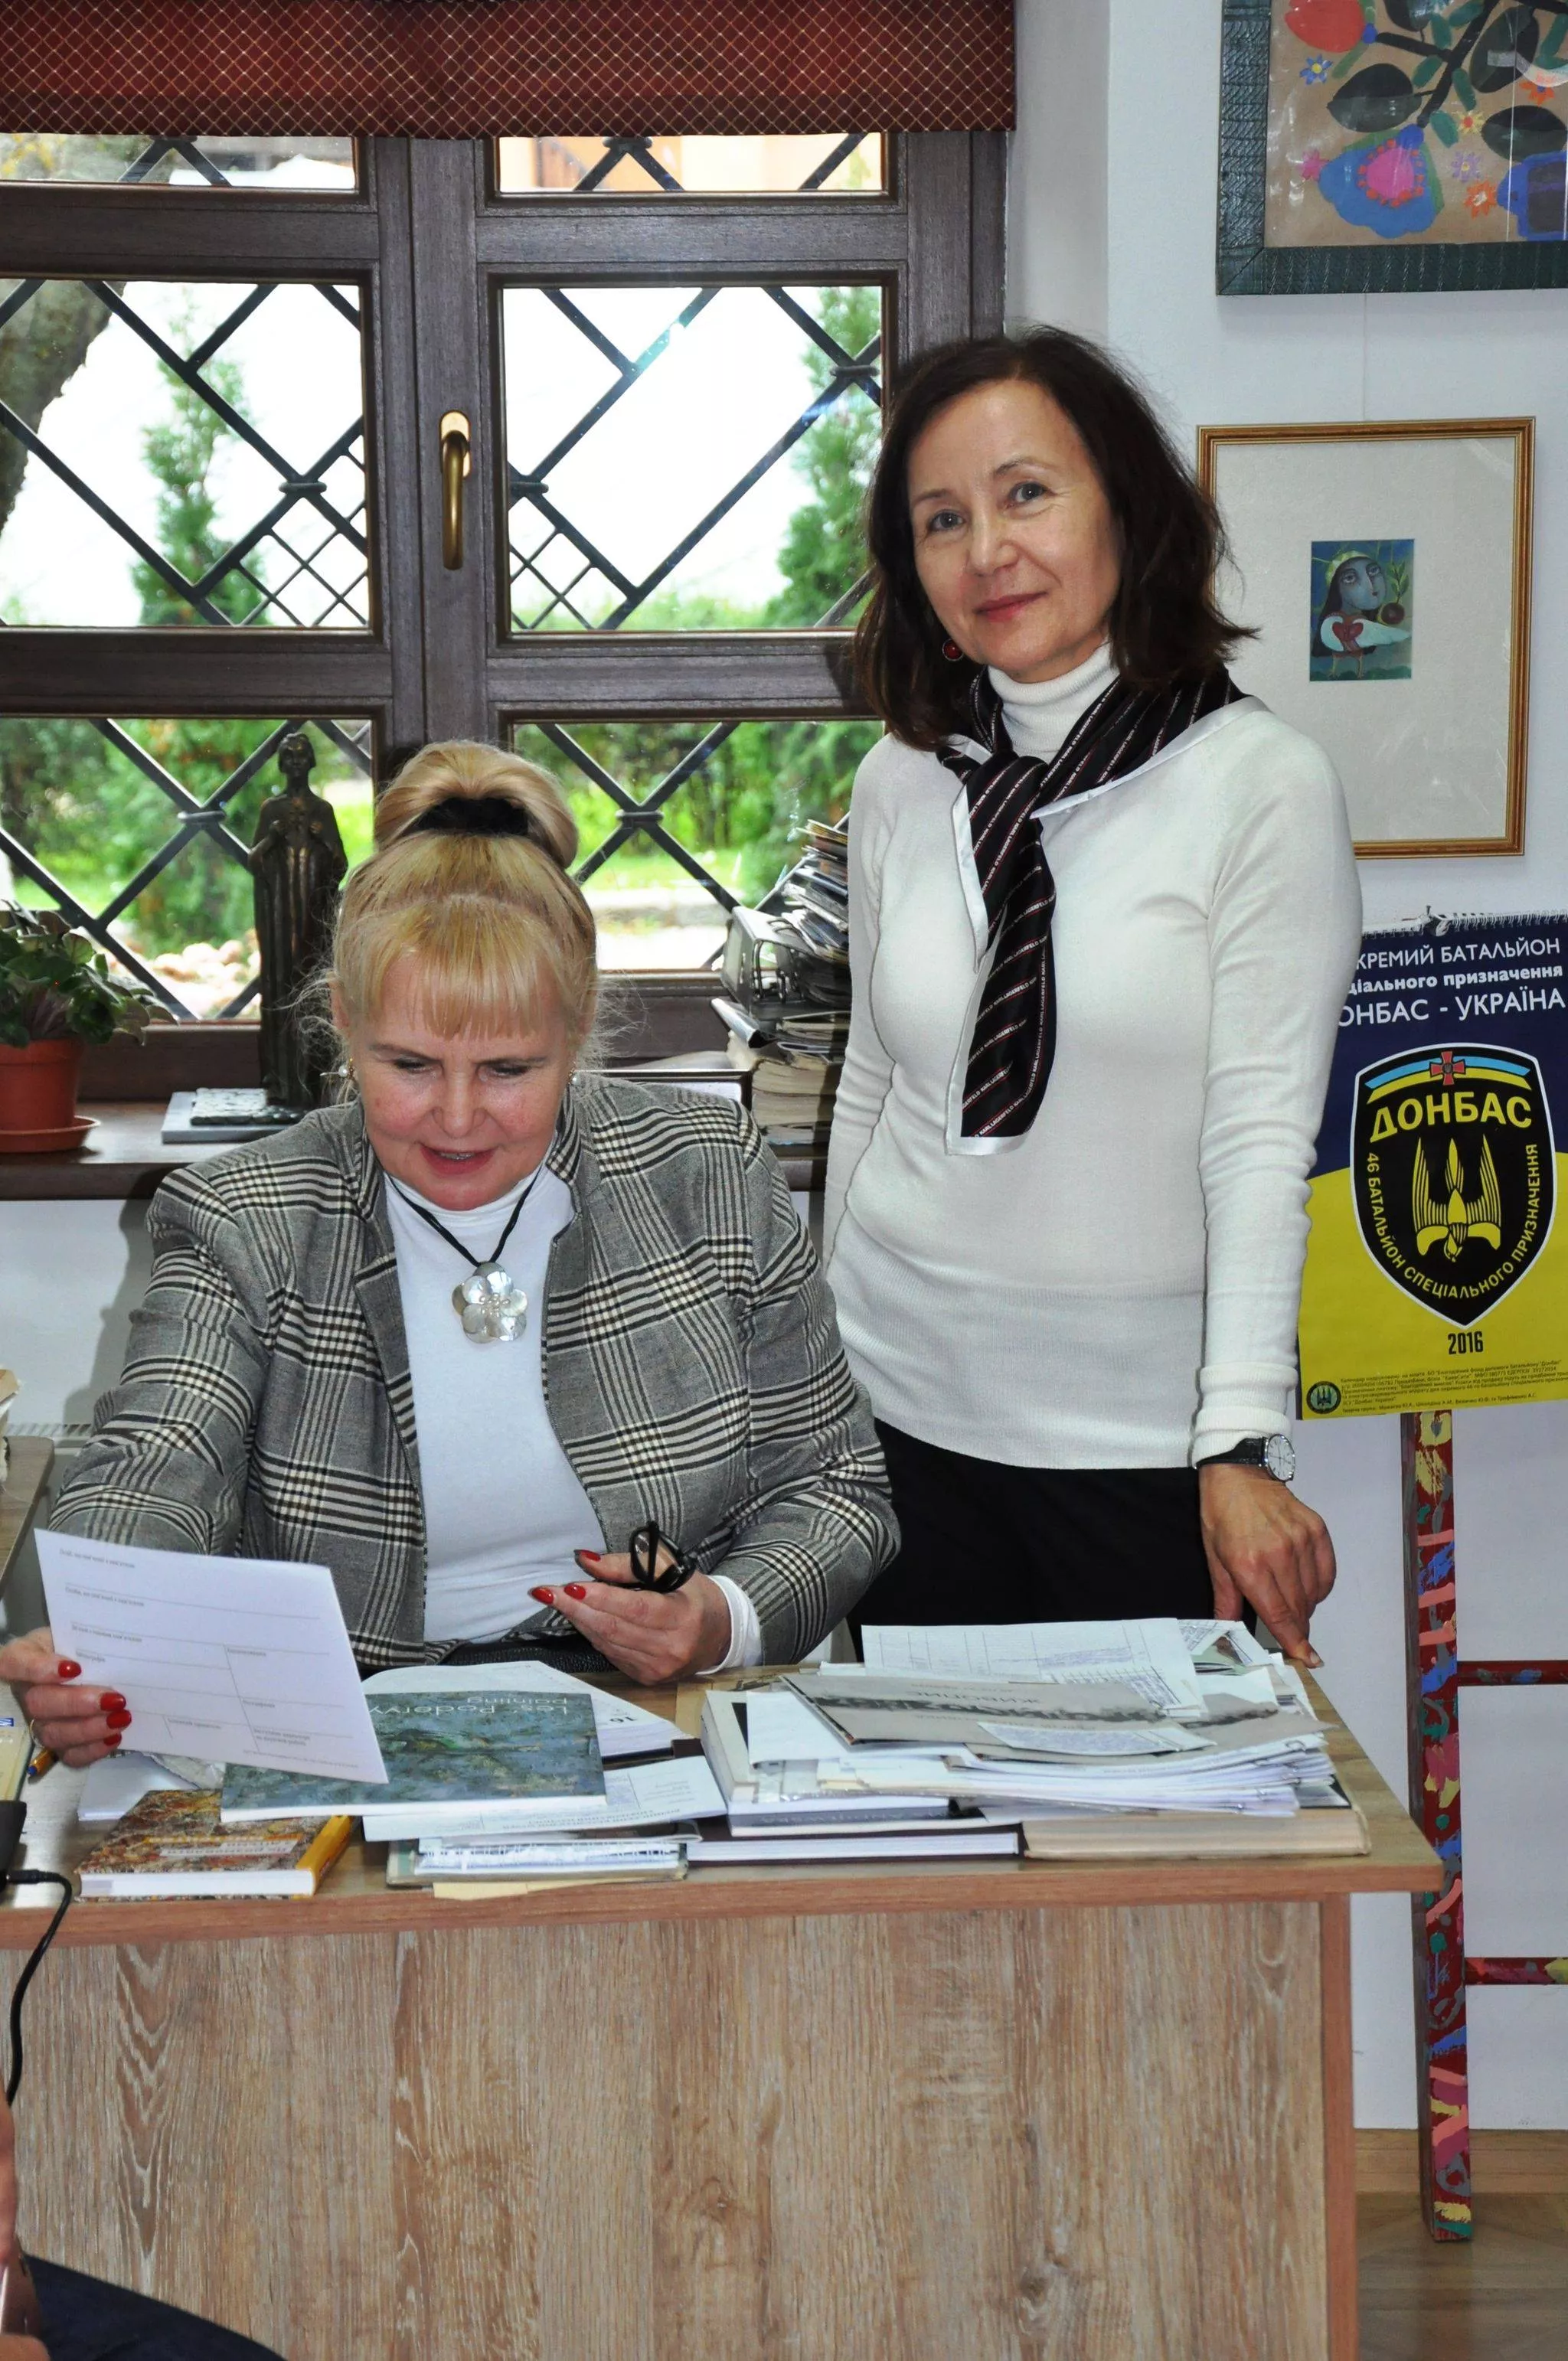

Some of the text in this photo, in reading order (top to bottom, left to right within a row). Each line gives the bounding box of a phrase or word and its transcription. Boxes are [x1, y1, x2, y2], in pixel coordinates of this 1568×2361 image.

[1072, 715, 1093, 746] LAGERFELD
[1106, 741, 1128, 772] LAGERFELD
[1009, 822, 1020, 836] KARL
[995, 835, 1012, 867] LAGERFELD
[987, 867, 996, 880] KARL
[1441, 937, 1560, 964] БАТАЛЬЙОН
[1444, 965, 1563, 988] призначення
[1455, 987, 1566, 1021] УКРАЇНА
[978, 1123, 993, 1136] KARL
[990, 1105, 1015, 1128] LAGERFELD
[1370, 1091, 1533, 1143] ДОНБАС
[1366, 1144, 1540, 1300] 46 БАТАЛЬЙОН СПЕЦІАЛЬНОГО ПРИЗНАЧЕННЯ
[1447, 1331, 1484, 1355] 2016
